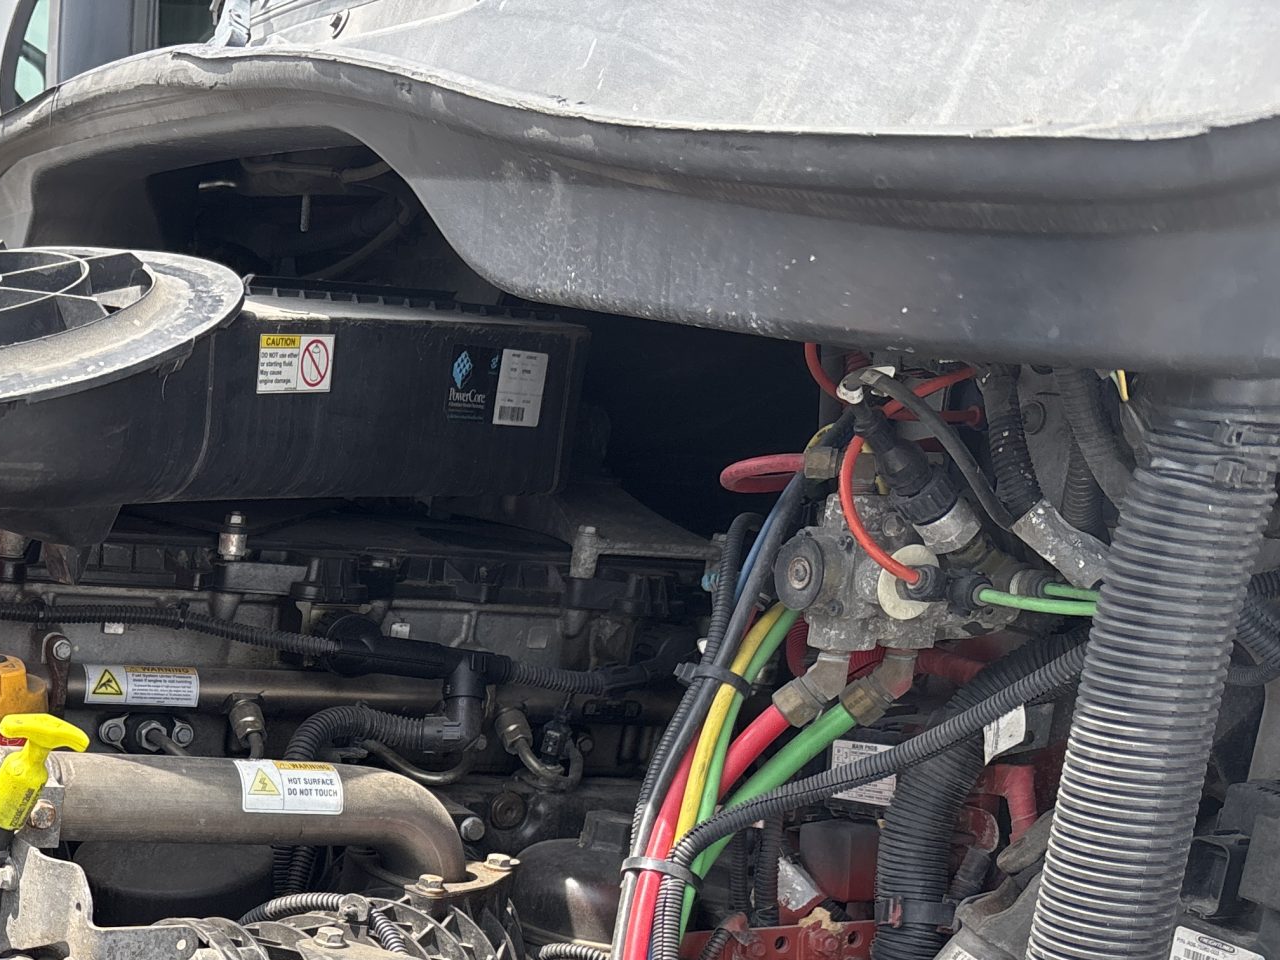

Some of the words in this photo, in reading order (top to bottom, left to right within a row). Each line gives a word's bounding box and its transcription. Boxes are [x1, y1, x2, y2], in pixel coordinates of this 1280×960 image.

[266, 338, 295, 346] CAUTION
[449, 388, 486, 403] PowerCore
[141, 666, 190, 674] WARNING
[288, 788, 297, 796] DO
[300, 788, 312, 796] NOT
[315, 789, 337, 797] TOUCH
